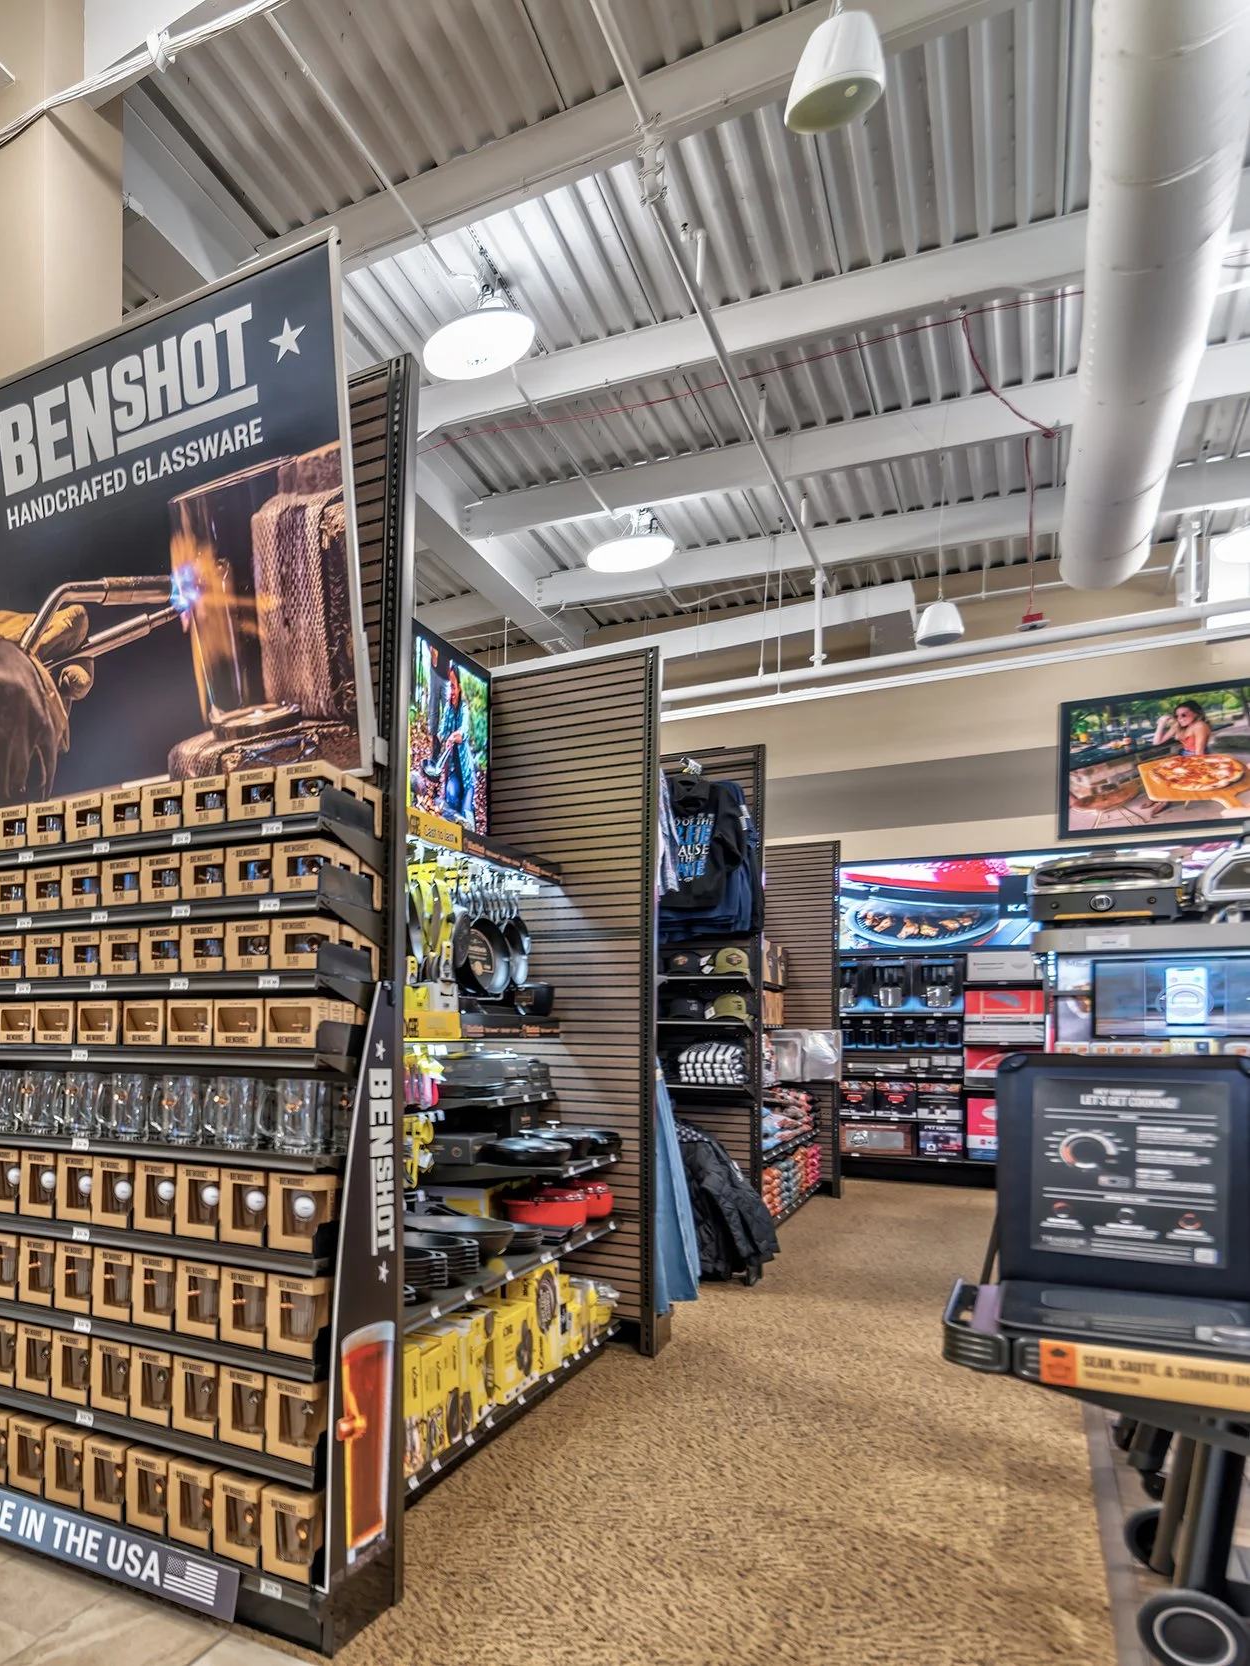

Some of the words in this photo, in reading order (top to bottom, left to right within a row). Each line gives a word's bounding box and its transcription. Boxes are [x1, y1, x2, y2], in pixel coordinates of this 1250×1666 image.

[7, 467, 127, 530] HANDCRAFED
[132, 416, 264, 486] GLASSWARE
[368, 1068, 395, 1252] BENSHOT
[18, 1506, 46, 1543] IN
[53, 1516, 102, 1564] THE
[106, 1536, 161, 1587] USA
